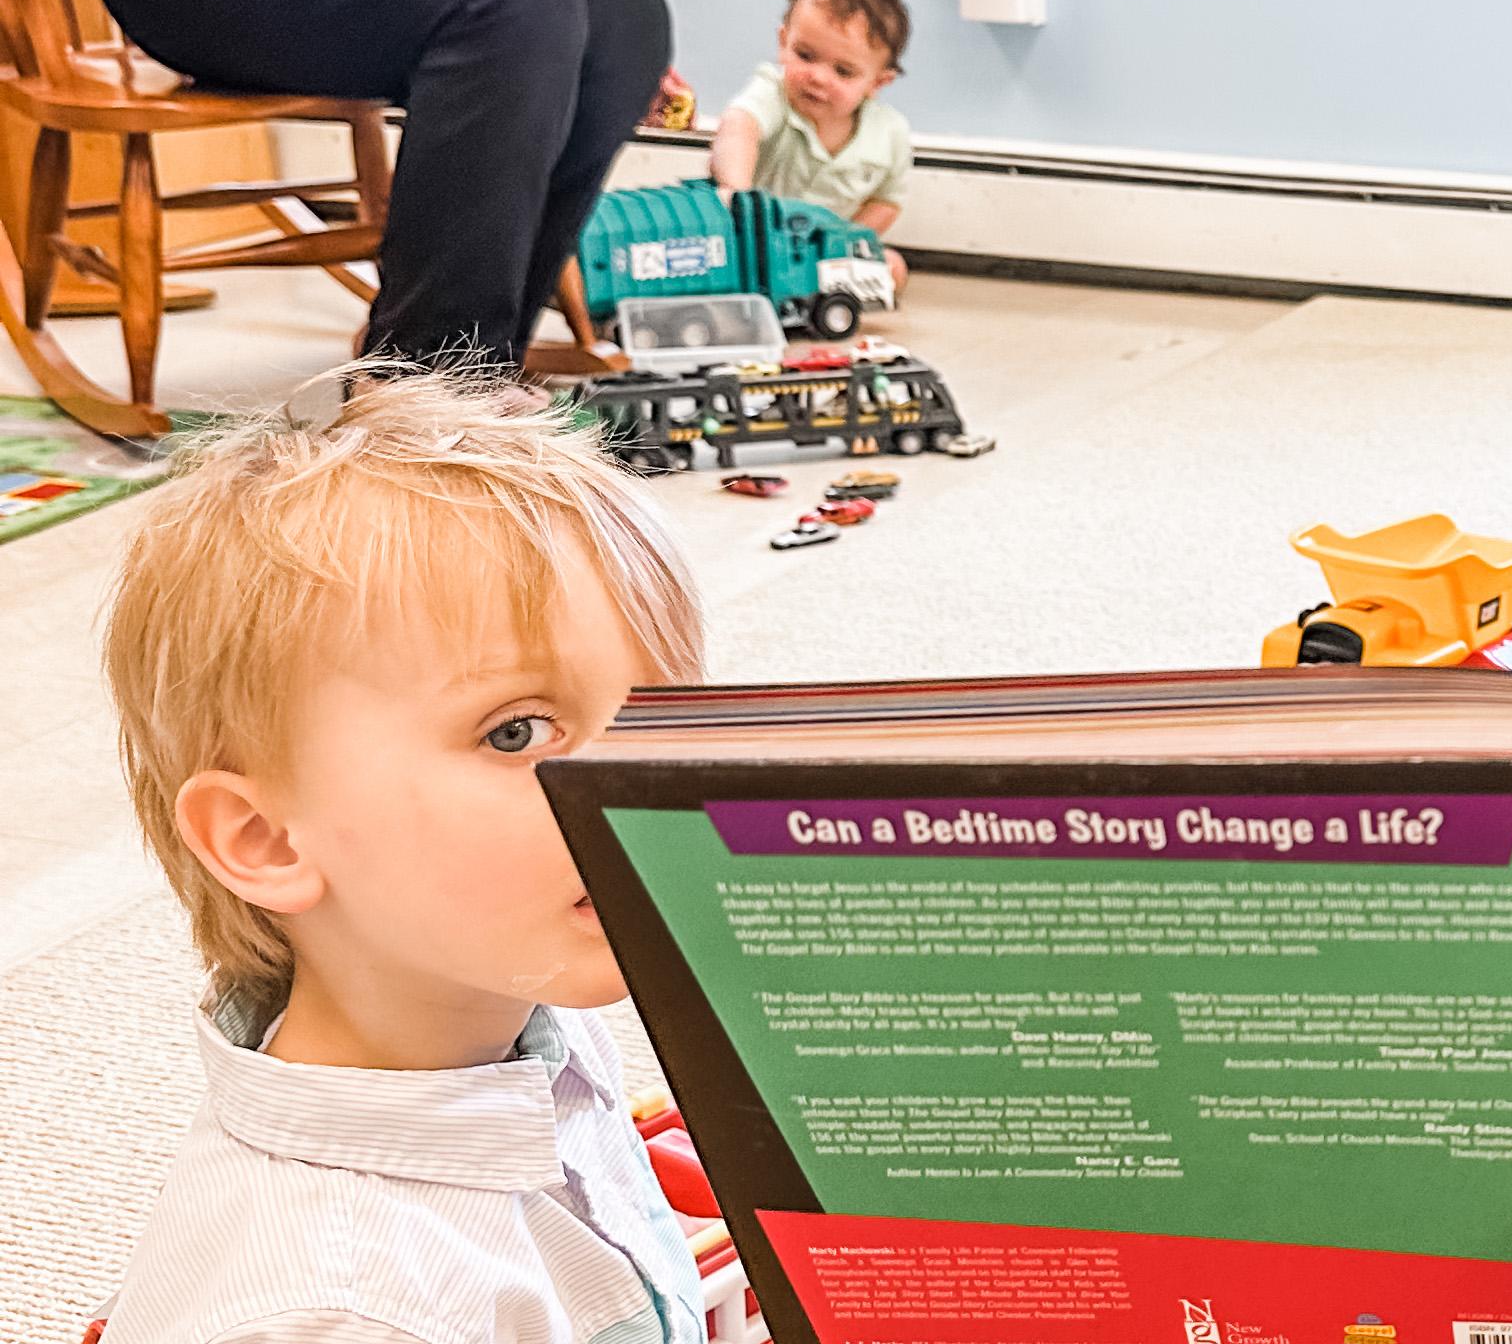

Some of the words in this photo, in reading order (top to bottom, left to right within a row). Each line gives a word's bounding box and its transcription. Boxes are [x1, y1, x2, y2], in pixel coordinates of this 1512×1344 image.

[786, 809, 863, 845] Can
[872, 818, 896, 844] a
[904, 808, 1057, 845] Bedtime
[1063, 807, 1167, 851] Story
[1175, 806, 1314, 852] Change
[1325, 818, 1348, 844] a
[1358, 808, 1444, 846] Life?
[1011, 1031, 1048, 1042] Dave
[1051, 1031, 1108, 1044] Harvey,
[1379, 1046, 1437, 1059] Timothy
[1441, 1047, 1476, 1058] Paul
[1075, 1155, 1120, 1168] Nancy
[1123, 1155, 1138, 1166] E.
[1143, 1155, 1179, 1166] Ganz
[1225, 1321, 1263, 1333] New
[1226, 1333, 1291, 1344] Growth
